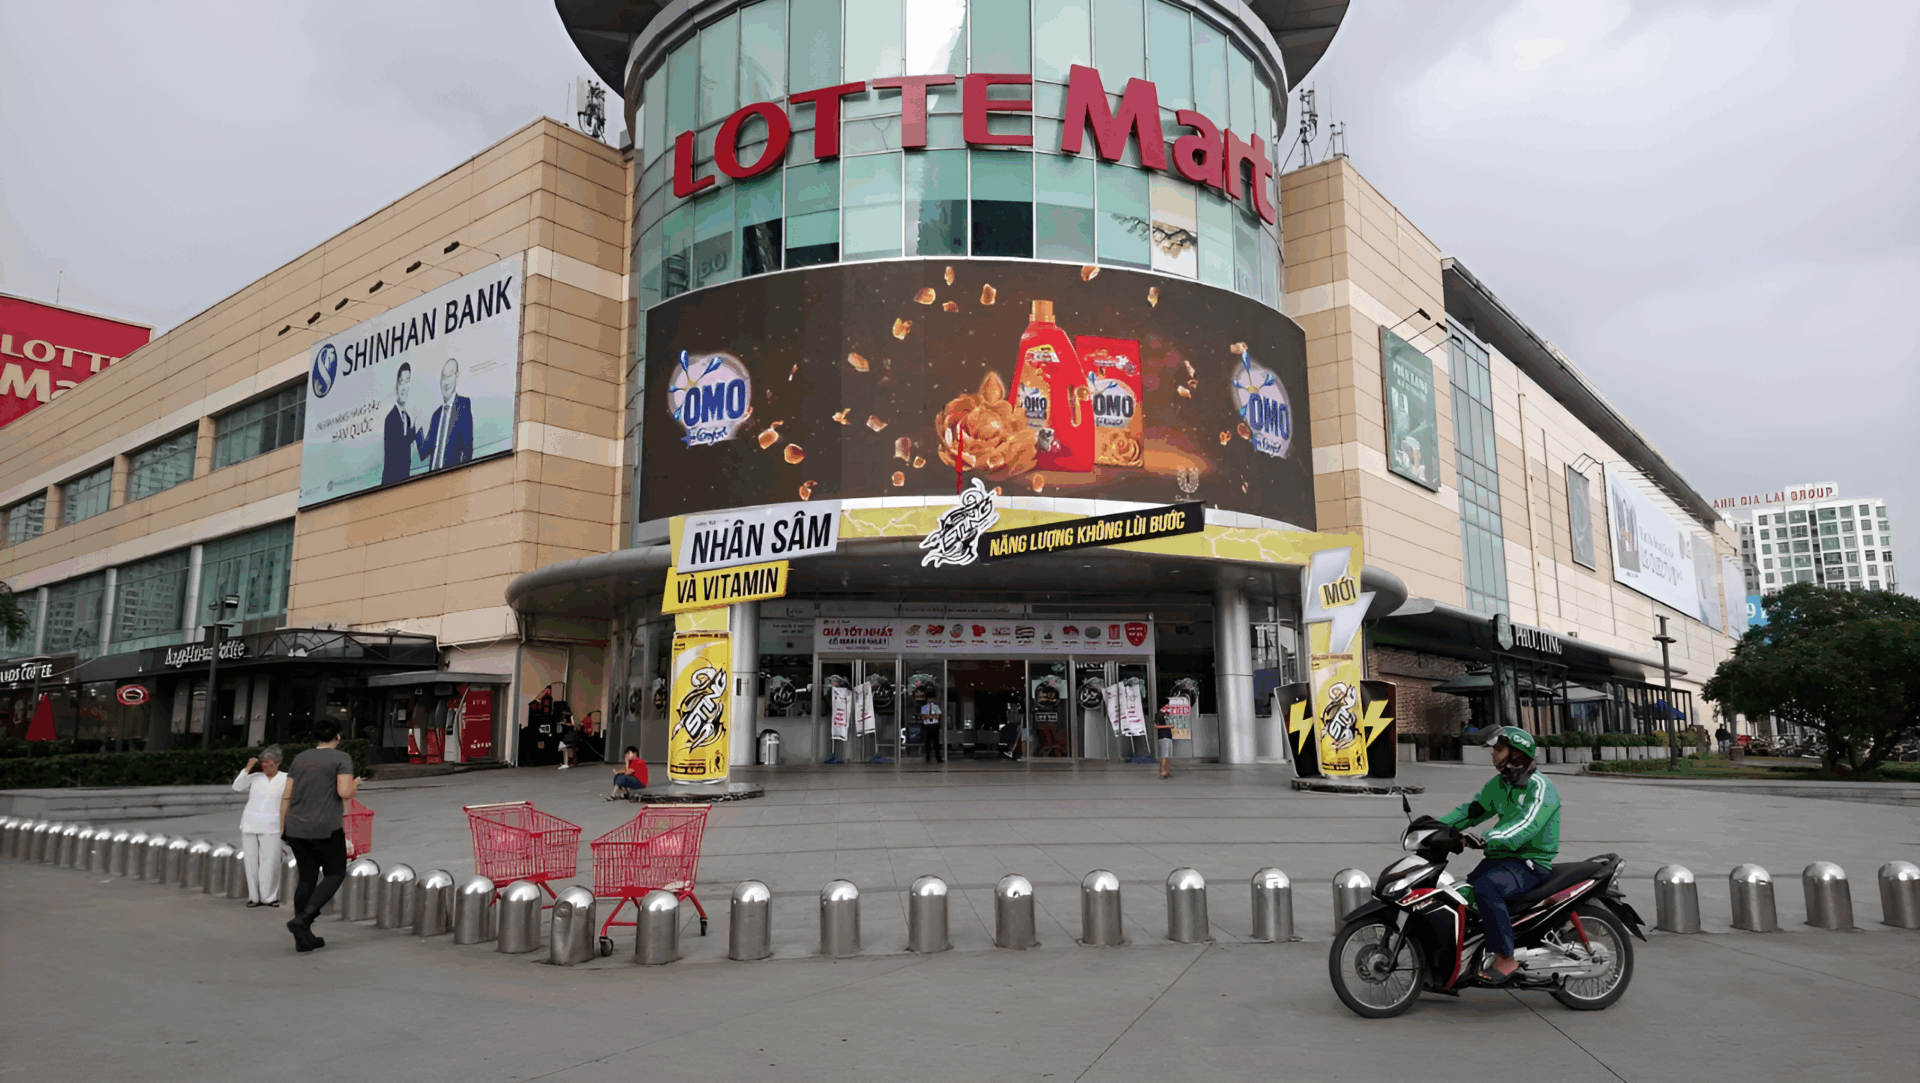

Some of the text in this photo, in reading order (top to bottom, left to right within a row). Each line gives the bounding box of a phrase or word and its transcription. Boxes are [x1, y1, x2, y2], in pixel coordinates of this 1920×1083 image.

[674, 64, 1275, 225] LOTTE Mart
[342, 276, 512, 376] SHINHAN BANK
[684, 379, 746, 426] OMO
[1093, 393, 1134, 418] OMO
[1250, 393, 1289, 441] OMO
[1766, 491, 1785, 503] LAI
[1791, 486, 1833, 501] GROUP
[691, 510, 832, 565] NHÂN SÂM
[989, 508, 1186, 557] NĂNG LƯỢNG KHÔNG LÙI BƯỚC
[677, 567, 778, 604] VÀ VITAMIN
[1323, 577, 1356, 605] MỚI
